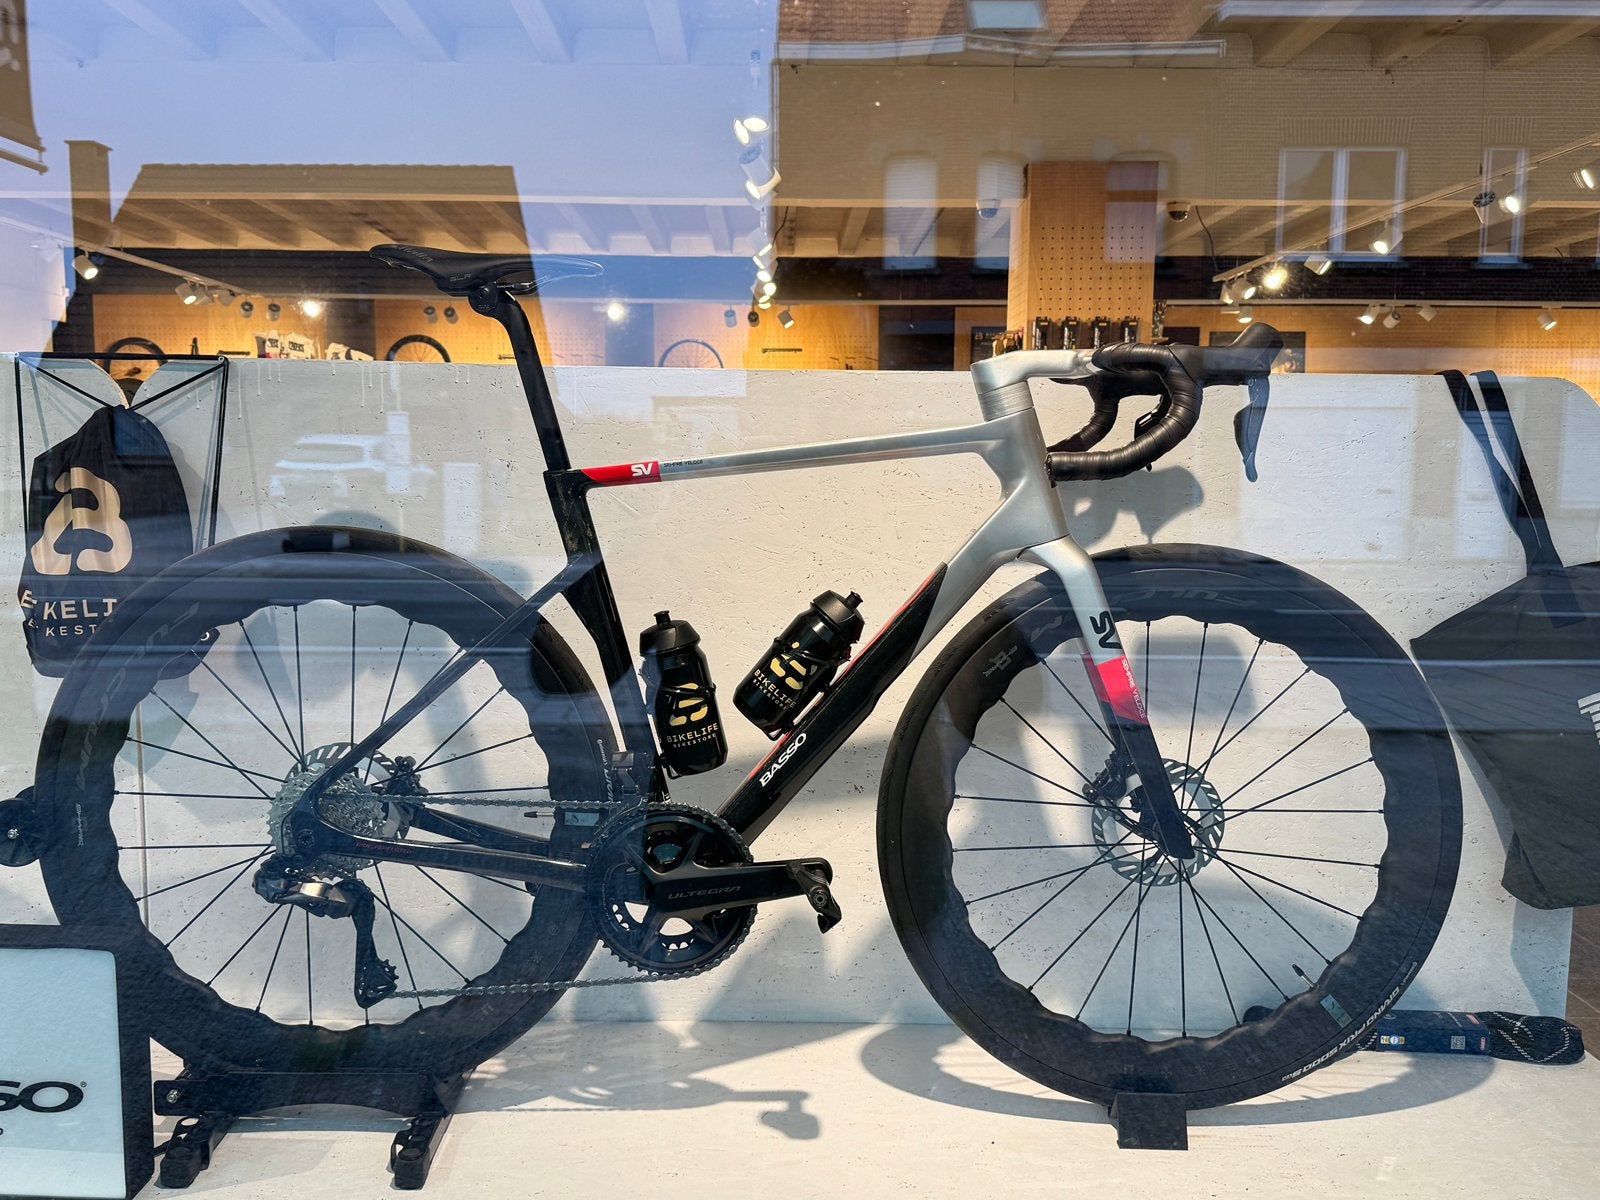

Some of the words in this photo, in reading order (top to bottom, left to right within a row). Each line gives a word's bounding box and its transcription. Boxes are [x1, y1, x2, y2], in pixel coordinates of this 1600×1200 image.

[630, 463, 653, 477] SV
[1089, 610, 1122, 650] SV
[754, 668, 797, 709] BIKELIFE
[666, 722, 719, 743] BIKELIFE
[672, 733, 717, 749] BIKESTORE
[759, 732, 807, 788] BASSO
[667, 885, 742, 900] ULTEGRA
[1366, 986, 1400, 1027] GRAND
[1338, 1023, 1366, 1051] PRIX
[1302, 1046, 1339, 1073] 5000
